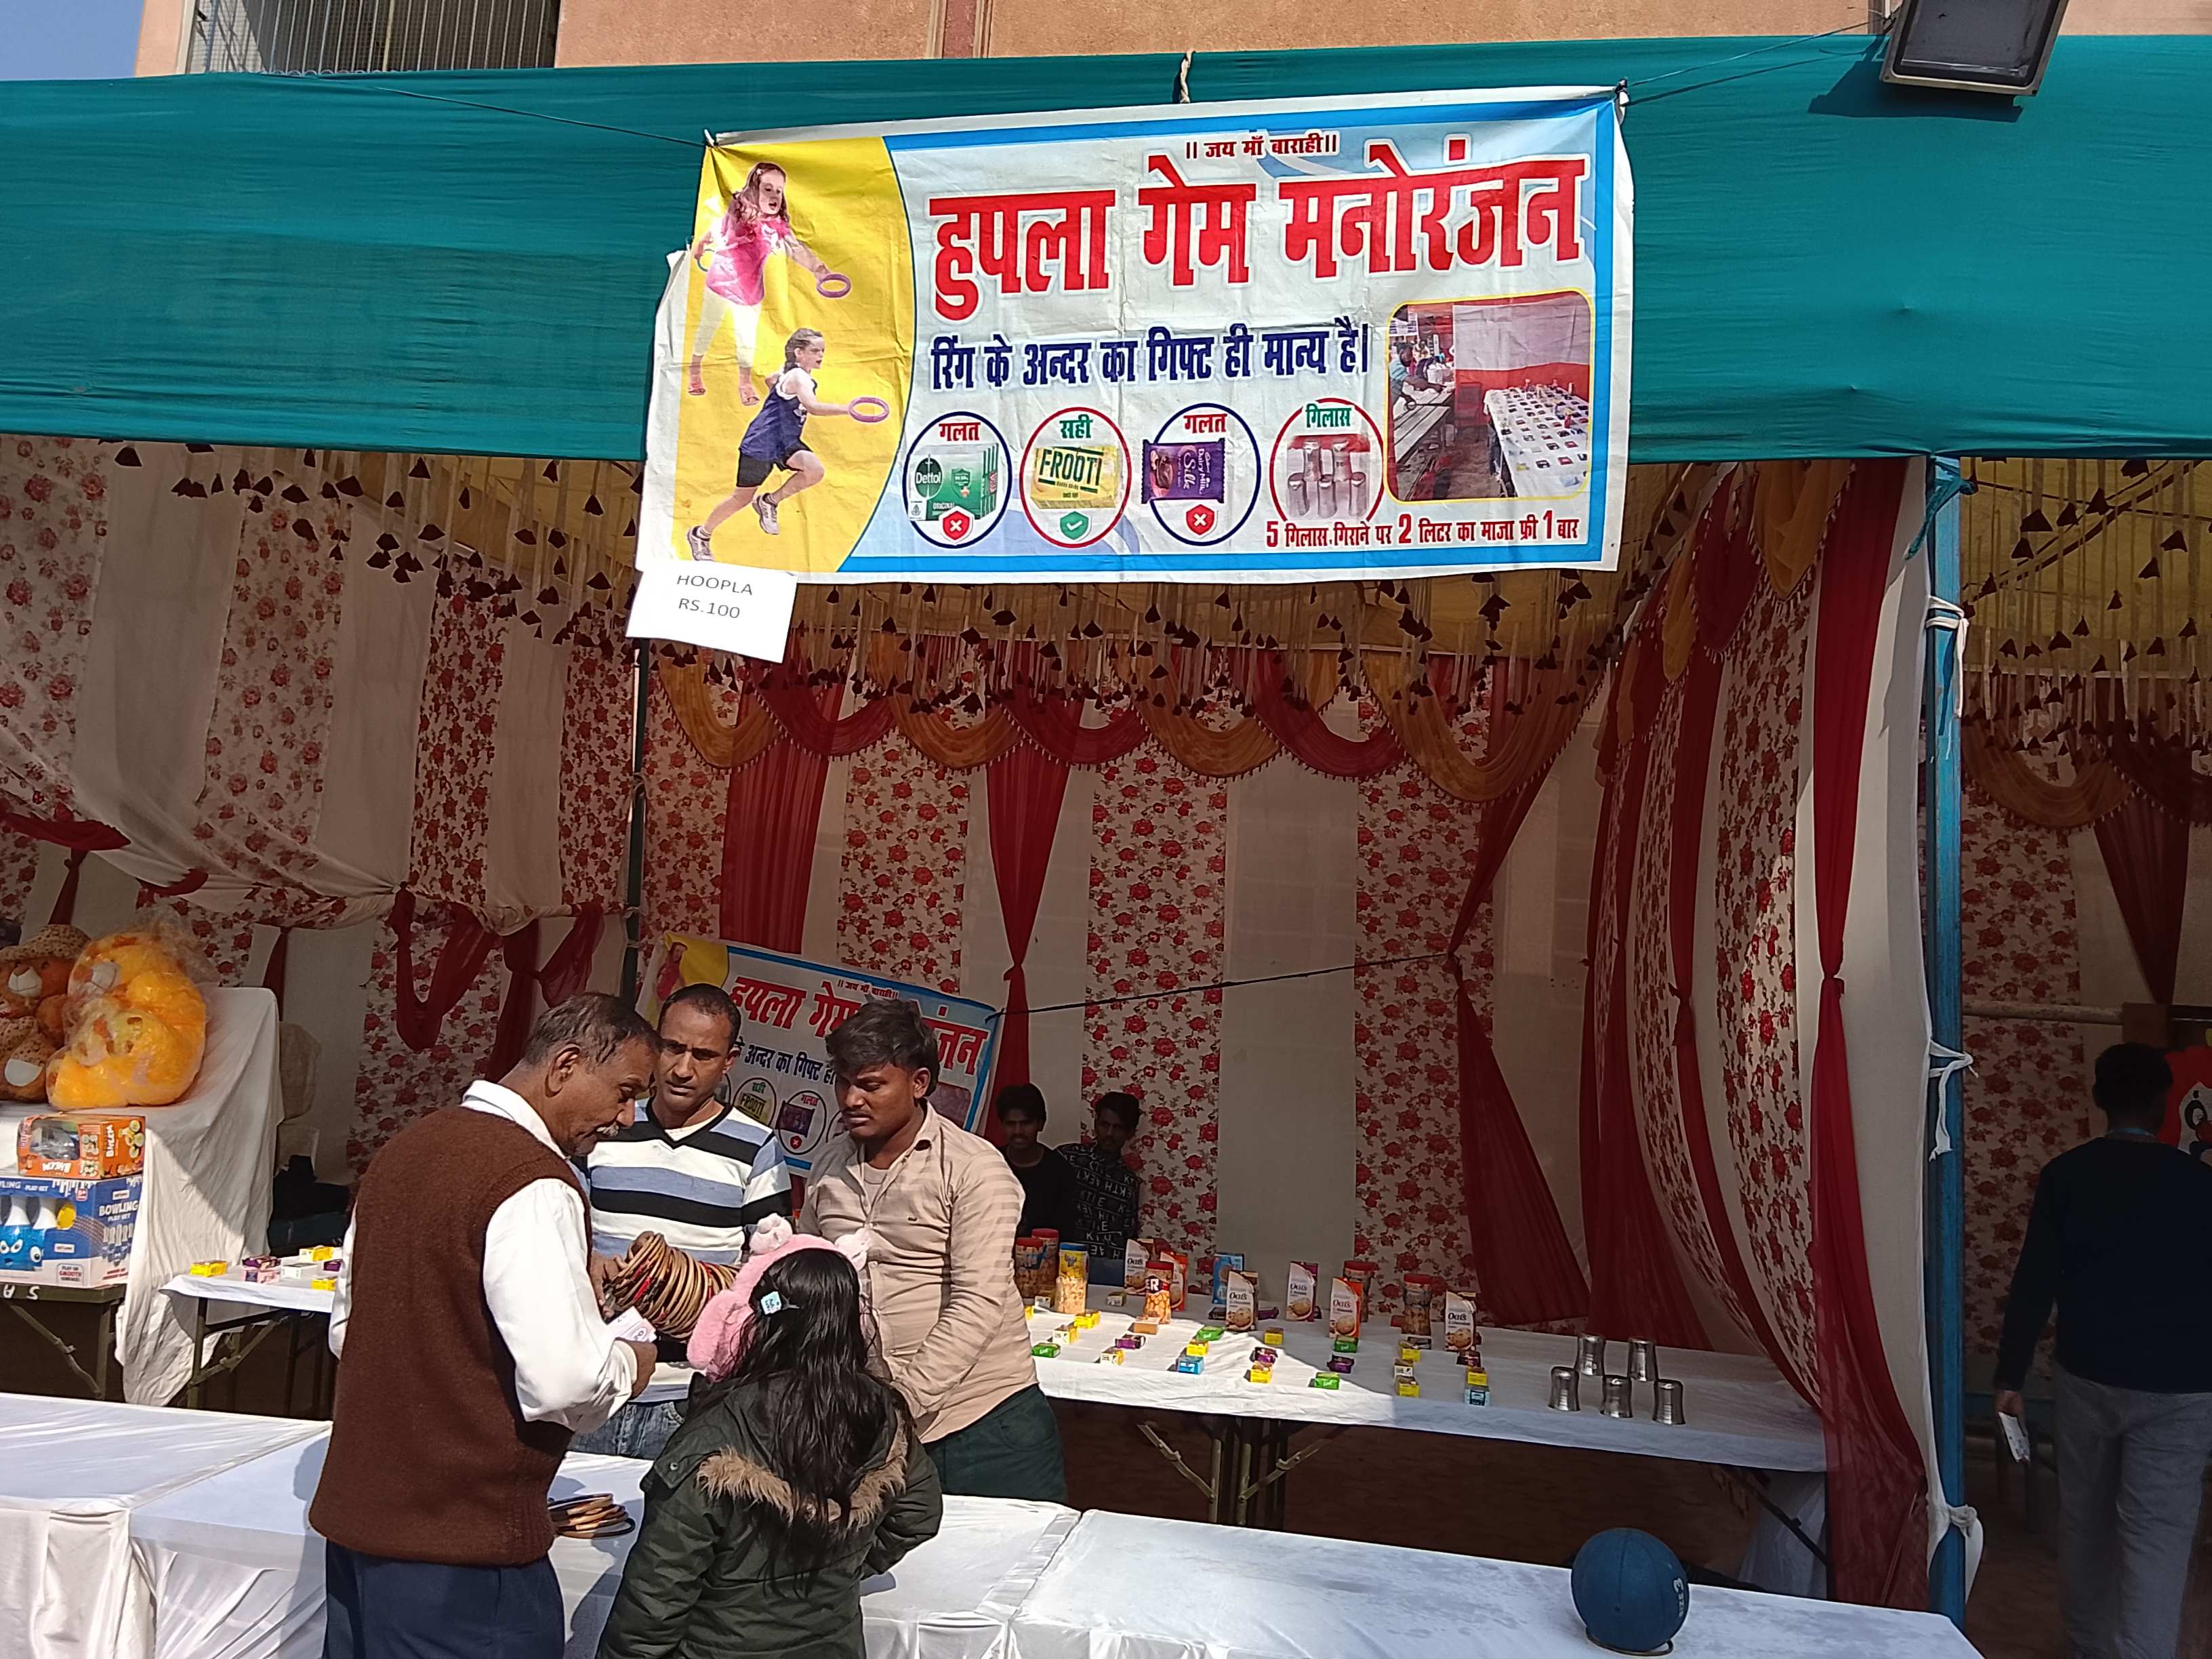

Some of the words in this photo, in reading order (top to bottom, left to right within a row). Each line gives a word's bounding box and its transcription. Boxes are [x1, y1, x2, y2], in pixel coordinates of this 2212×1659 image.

[1204, 141, 1237, 158] जय
[1242, 135, 1265, 156] माँ
[929, 189, 1116, 321] हुपला
[1138, 155, 1257, 286] गेम
[1278, 139, 1586, 279] मनोरंजन
[930, 335, 976, 390] रिंग
[983, 333, 1013, 387] के
[1023, 342, 1092, 385] अन्दर
[1100, 340, 1139, 382] का
[1146, 326, 1214, 381] गिफ्ट
[1223, 323, 1254, 377] ही
[1262, 331, 1330, 375] मान्य
[1059, 413, 1093, 438] सही
[1183, 413, 1228, 434] गलत
[1305, 403, 1352, 428] गिलास
[939, 422, 981, 441] गलत
[916, 472, 941, 484] Dettol
[1039, 448, 1103, 487] FROOTI
[1183, 452, 1196, 490] Silk
[1267, 520, 1279, 548] 5
[1333, 520, 1370, 546] गिराने
[1375, 525, 1393, 544] पर
[1398, 514, 1412, 544] 2
[1418, 518, 1452, 543] लिटर
[1457, 522, 1476, 541] का
[1480, 520, 1515, 541] माजा
[1542, 510, 1553, 539] 1
[1557, 518, 1580, 539] बार
[676, 575, 753, 595] HOOPLA
[678, 598, 741, 619] RS.100
[744, 1044, 776, 1069] अन्दर
[775, 1051, 794, 1074] का
[793, 1051, 824, 1081] गिफ्ट
[739, 1092, 766, 1116] FROOTI
[98, 1200, 138, 1216] BOWLING
[1229, 1292, 1248, 1300] Oats
[1448, 1312, 1467, 1321] Oats
